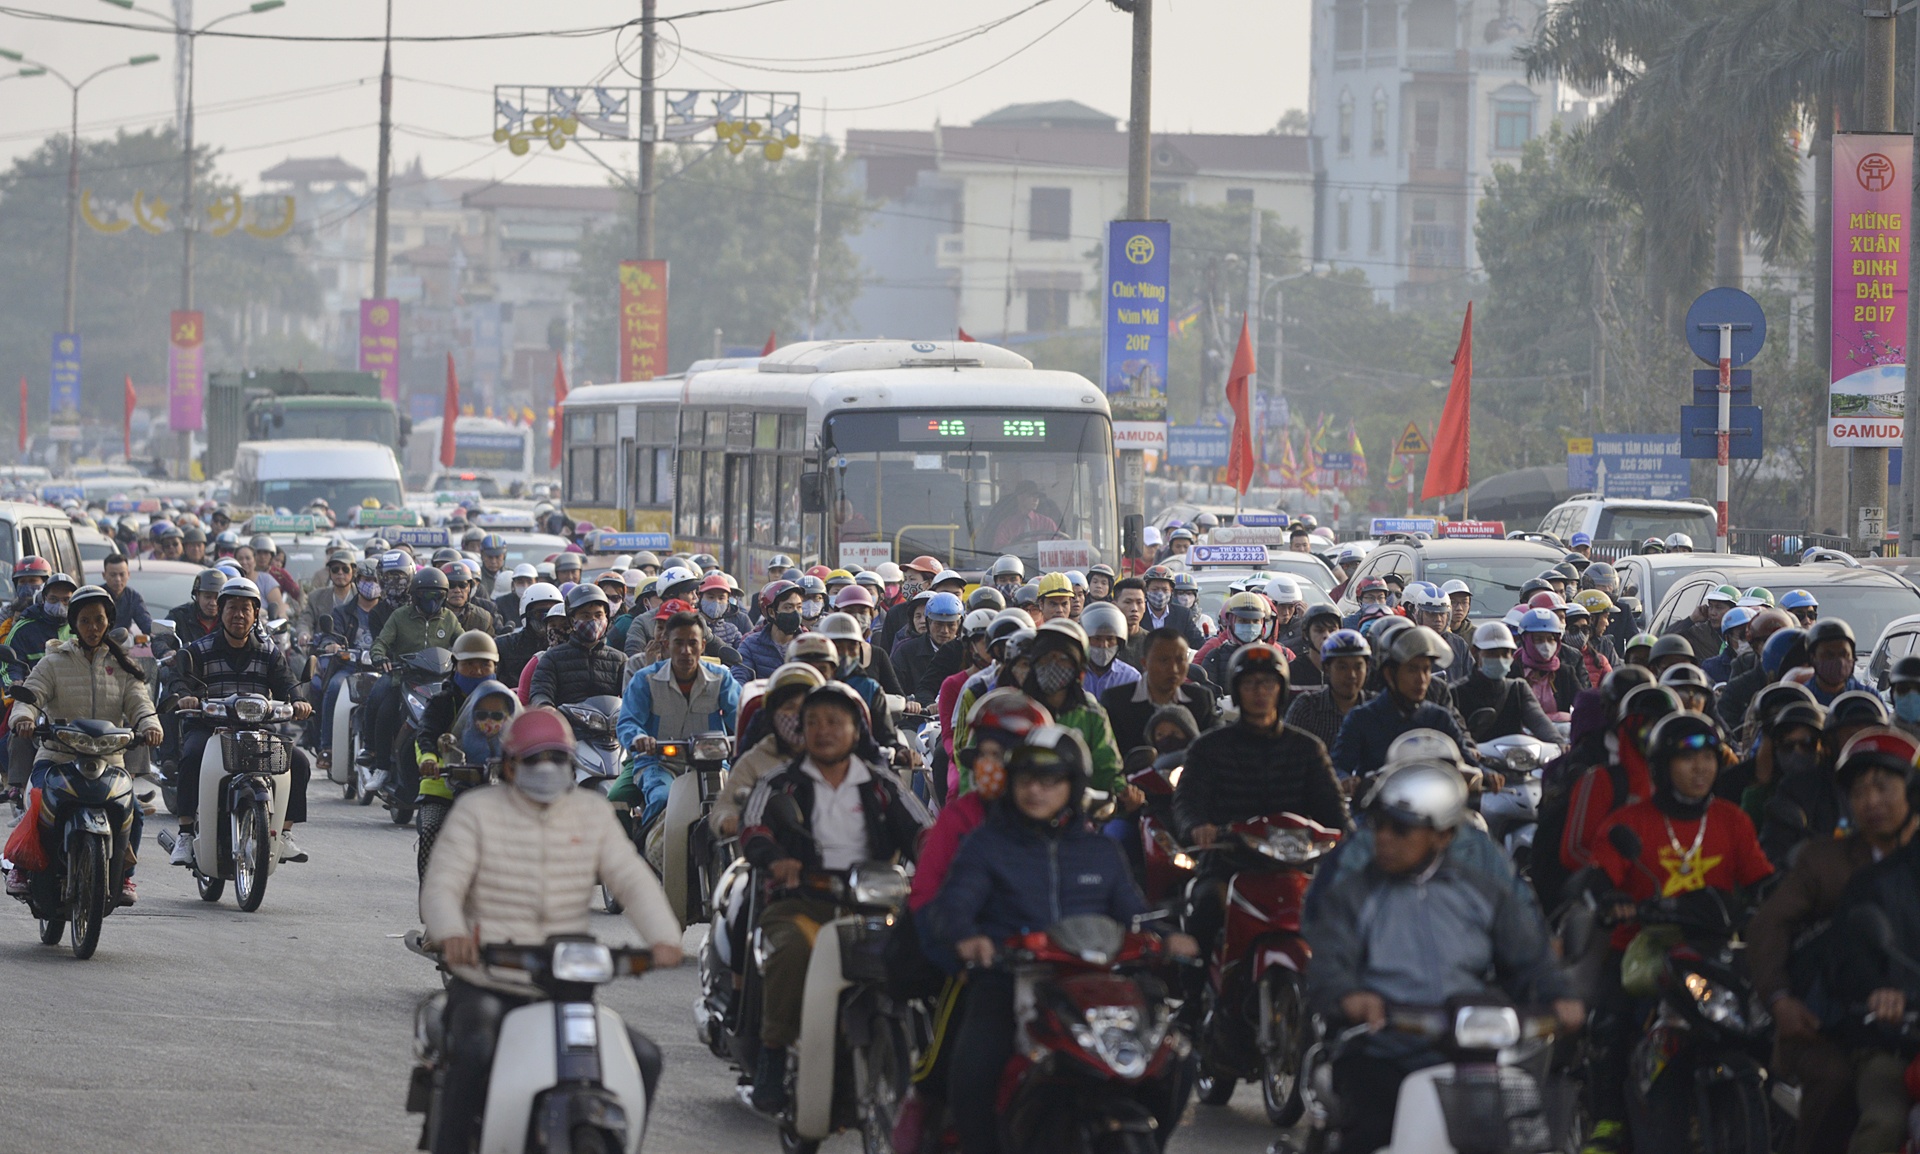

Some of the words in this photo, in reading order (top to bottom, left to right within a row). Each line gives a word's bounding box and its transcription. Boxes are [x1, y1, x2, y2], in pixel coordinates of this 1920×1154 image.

[1850, 210, 1901, 230] MỪNG
[1850, 233, 1900, 253] XUÂN
[1852, 259, 1898, 276] ĐINH
[1856, 279, 1893, 303] DẬU
[1854, 306, 1895, 322] 2017
[1126, 334, 1150, 351] 2017
[1446, 525, 1468, 533] XUÂN
[1469, 525, 1495, 533] THÀNH
[401, 533, 416, 543] SAO
[618, 537, 635, 546] TAXI
[635, 537, 650, 546] SAO
